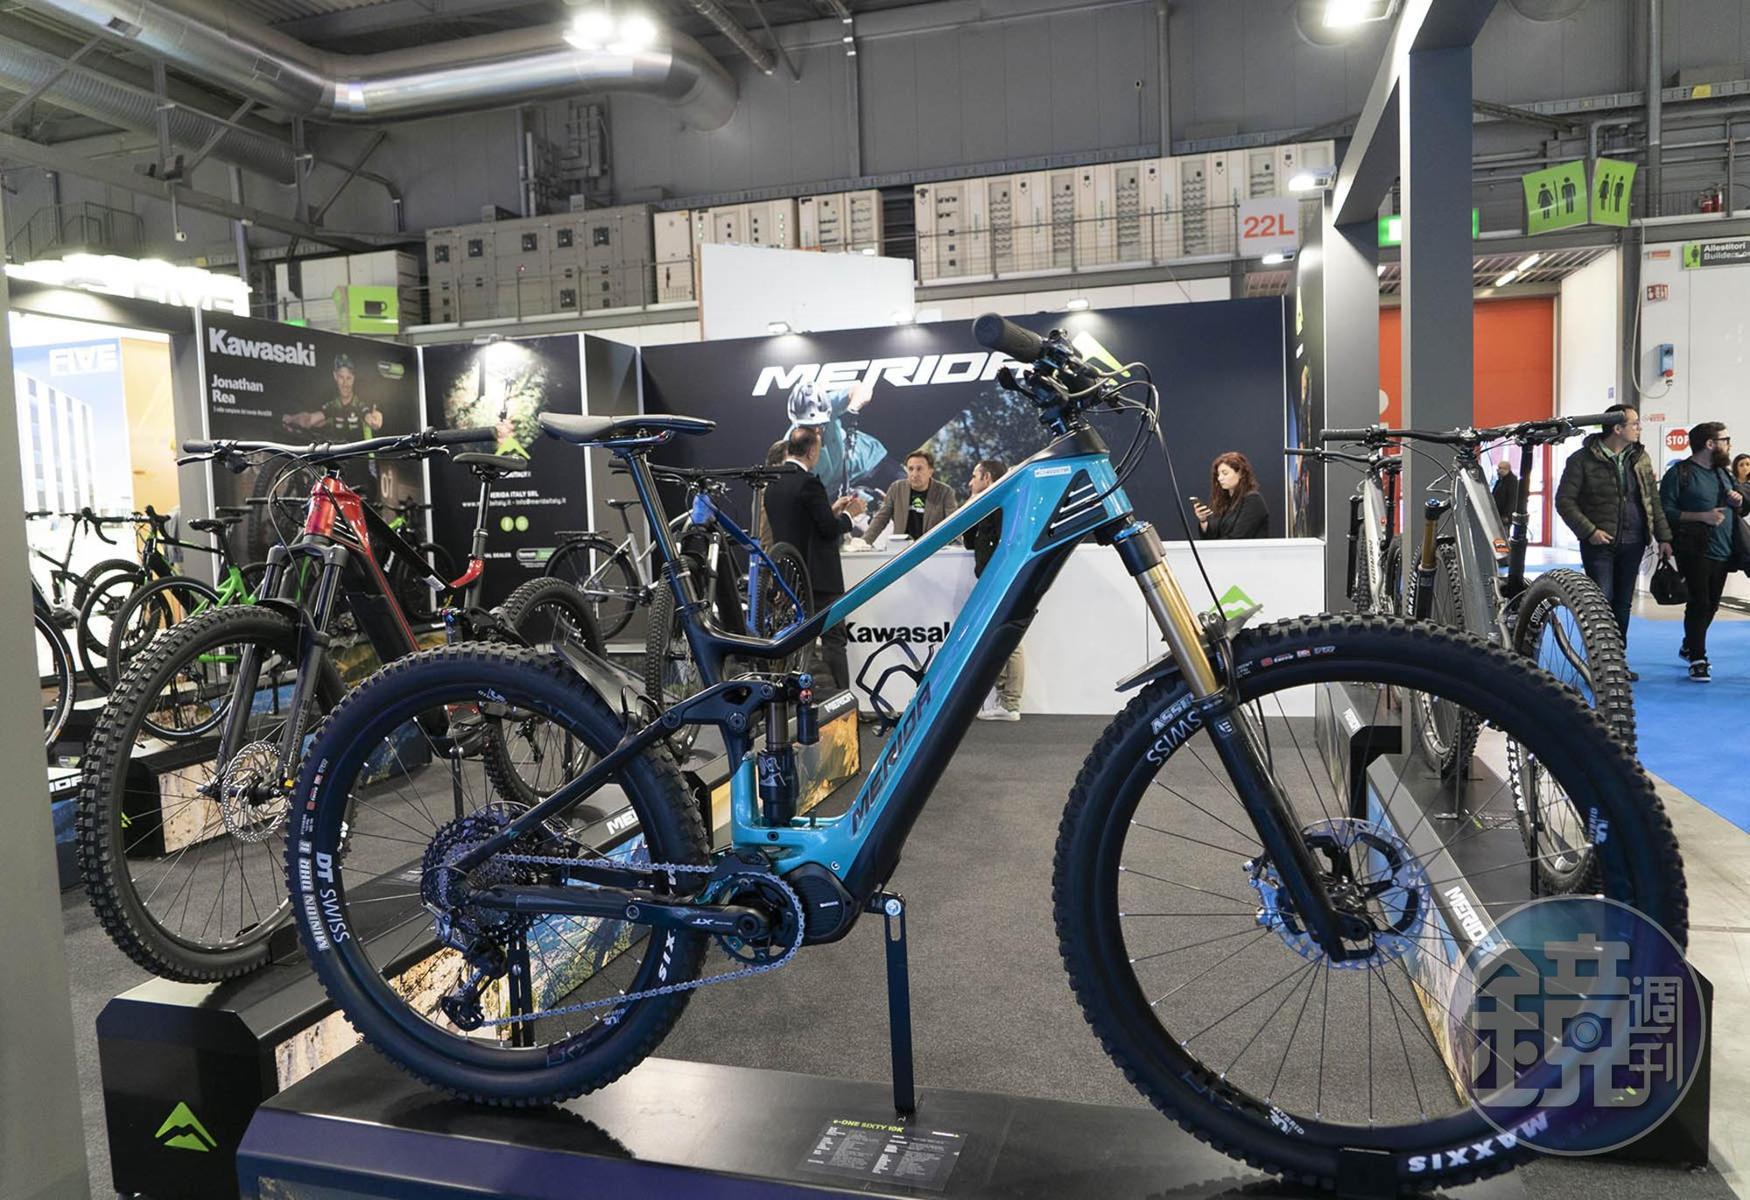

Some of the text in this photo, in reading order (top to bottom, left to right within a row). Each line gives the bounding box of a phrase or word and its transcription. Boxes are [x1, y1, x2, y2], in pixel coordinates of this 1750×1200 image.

[1243, 213, 1296, 239] 22L
[1703, 242, 1746, 252] Allestitori
[208, 327, 316, 367] Kawasaki
[211, 374, 264, 392] Jonathan
[212, 389, 236, 404] Rea
[846, 621, 950, 643] Kawasa
[1147, 711, 1202, 767] SWISS
[851, 680, 932, 838] MERIDA
[299, 858, 314, 892] DHR
[316, 851, 351, 944] DT SWISS
[302, 893, 330, 951] MINION
[1444, 885, 1498, 956] MERIDA
[832, 1119, 861, 1128] e-ONE
[861, 1122, 888, 1132] SIXTY
[1407, 1110, 1549, 1173] MAXXIS
